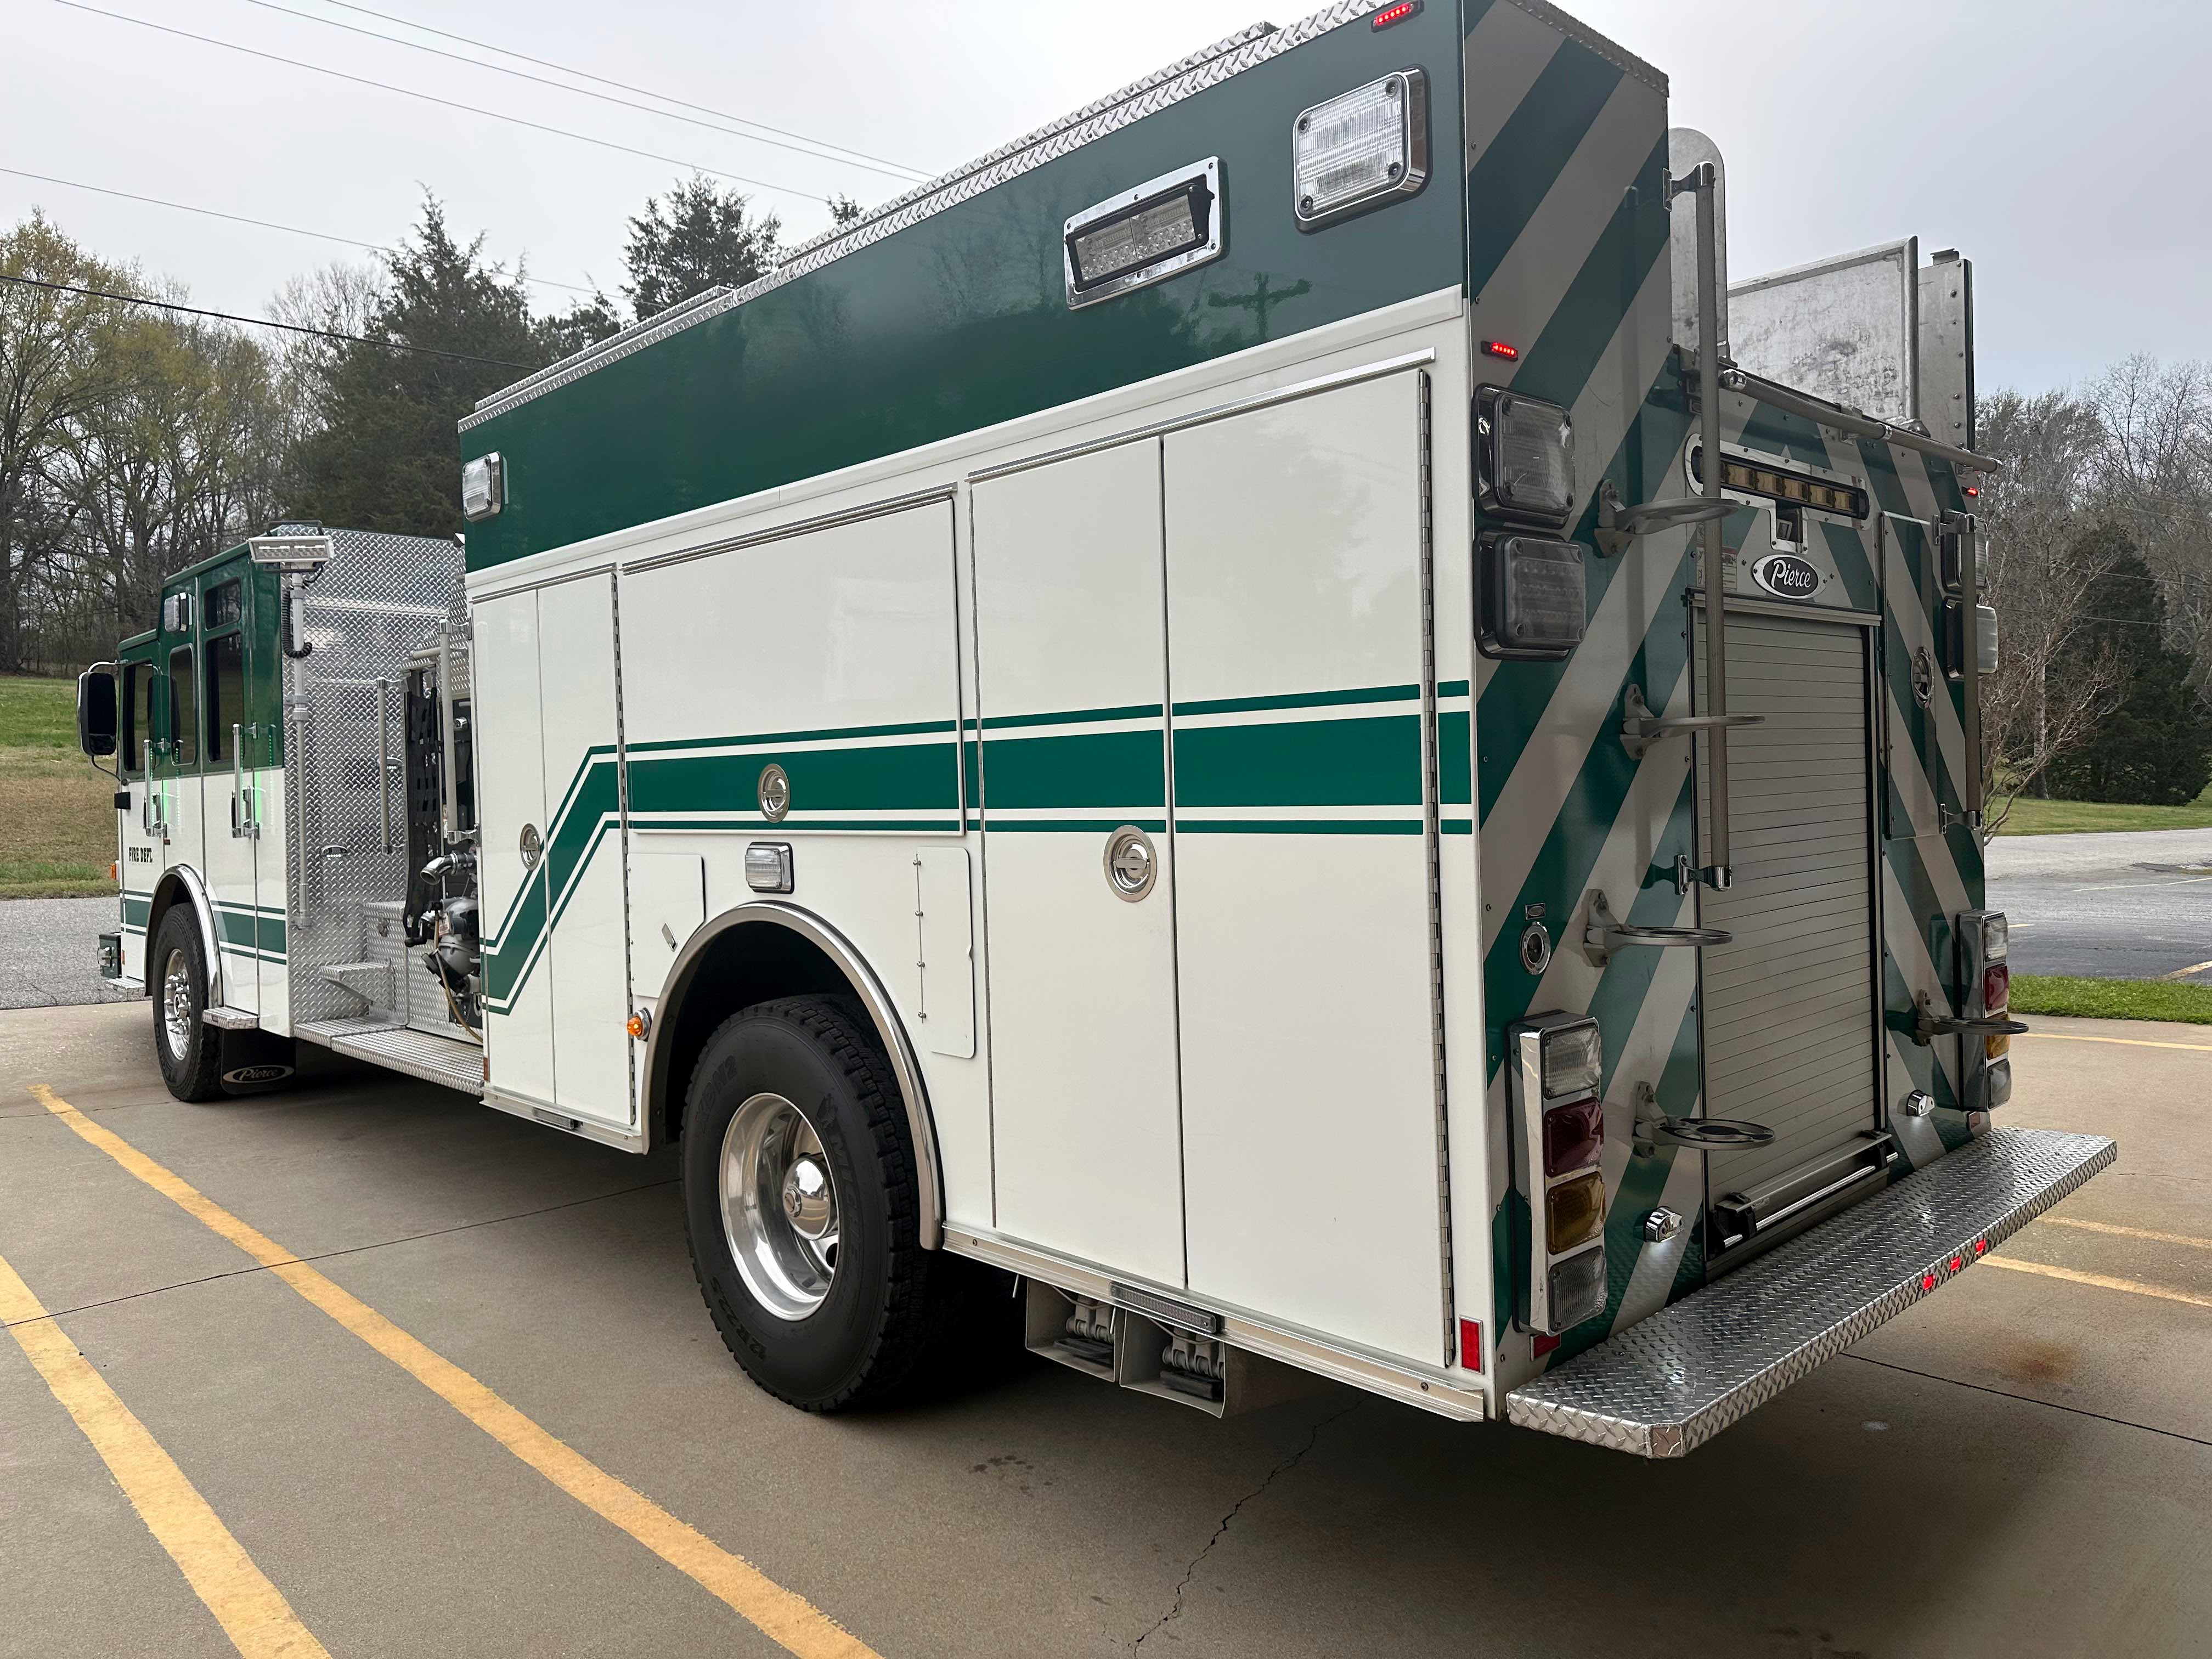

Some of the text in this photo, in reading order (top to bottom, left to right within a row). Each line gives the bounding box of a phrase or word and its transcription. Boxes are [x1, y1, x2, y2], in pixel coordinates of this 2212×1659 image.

[1771, 559, 1811, 589] Pierce
[128, 847, 153, 863] FIRE DEPT.
[239, 1068, 278, 1081] Pierce
